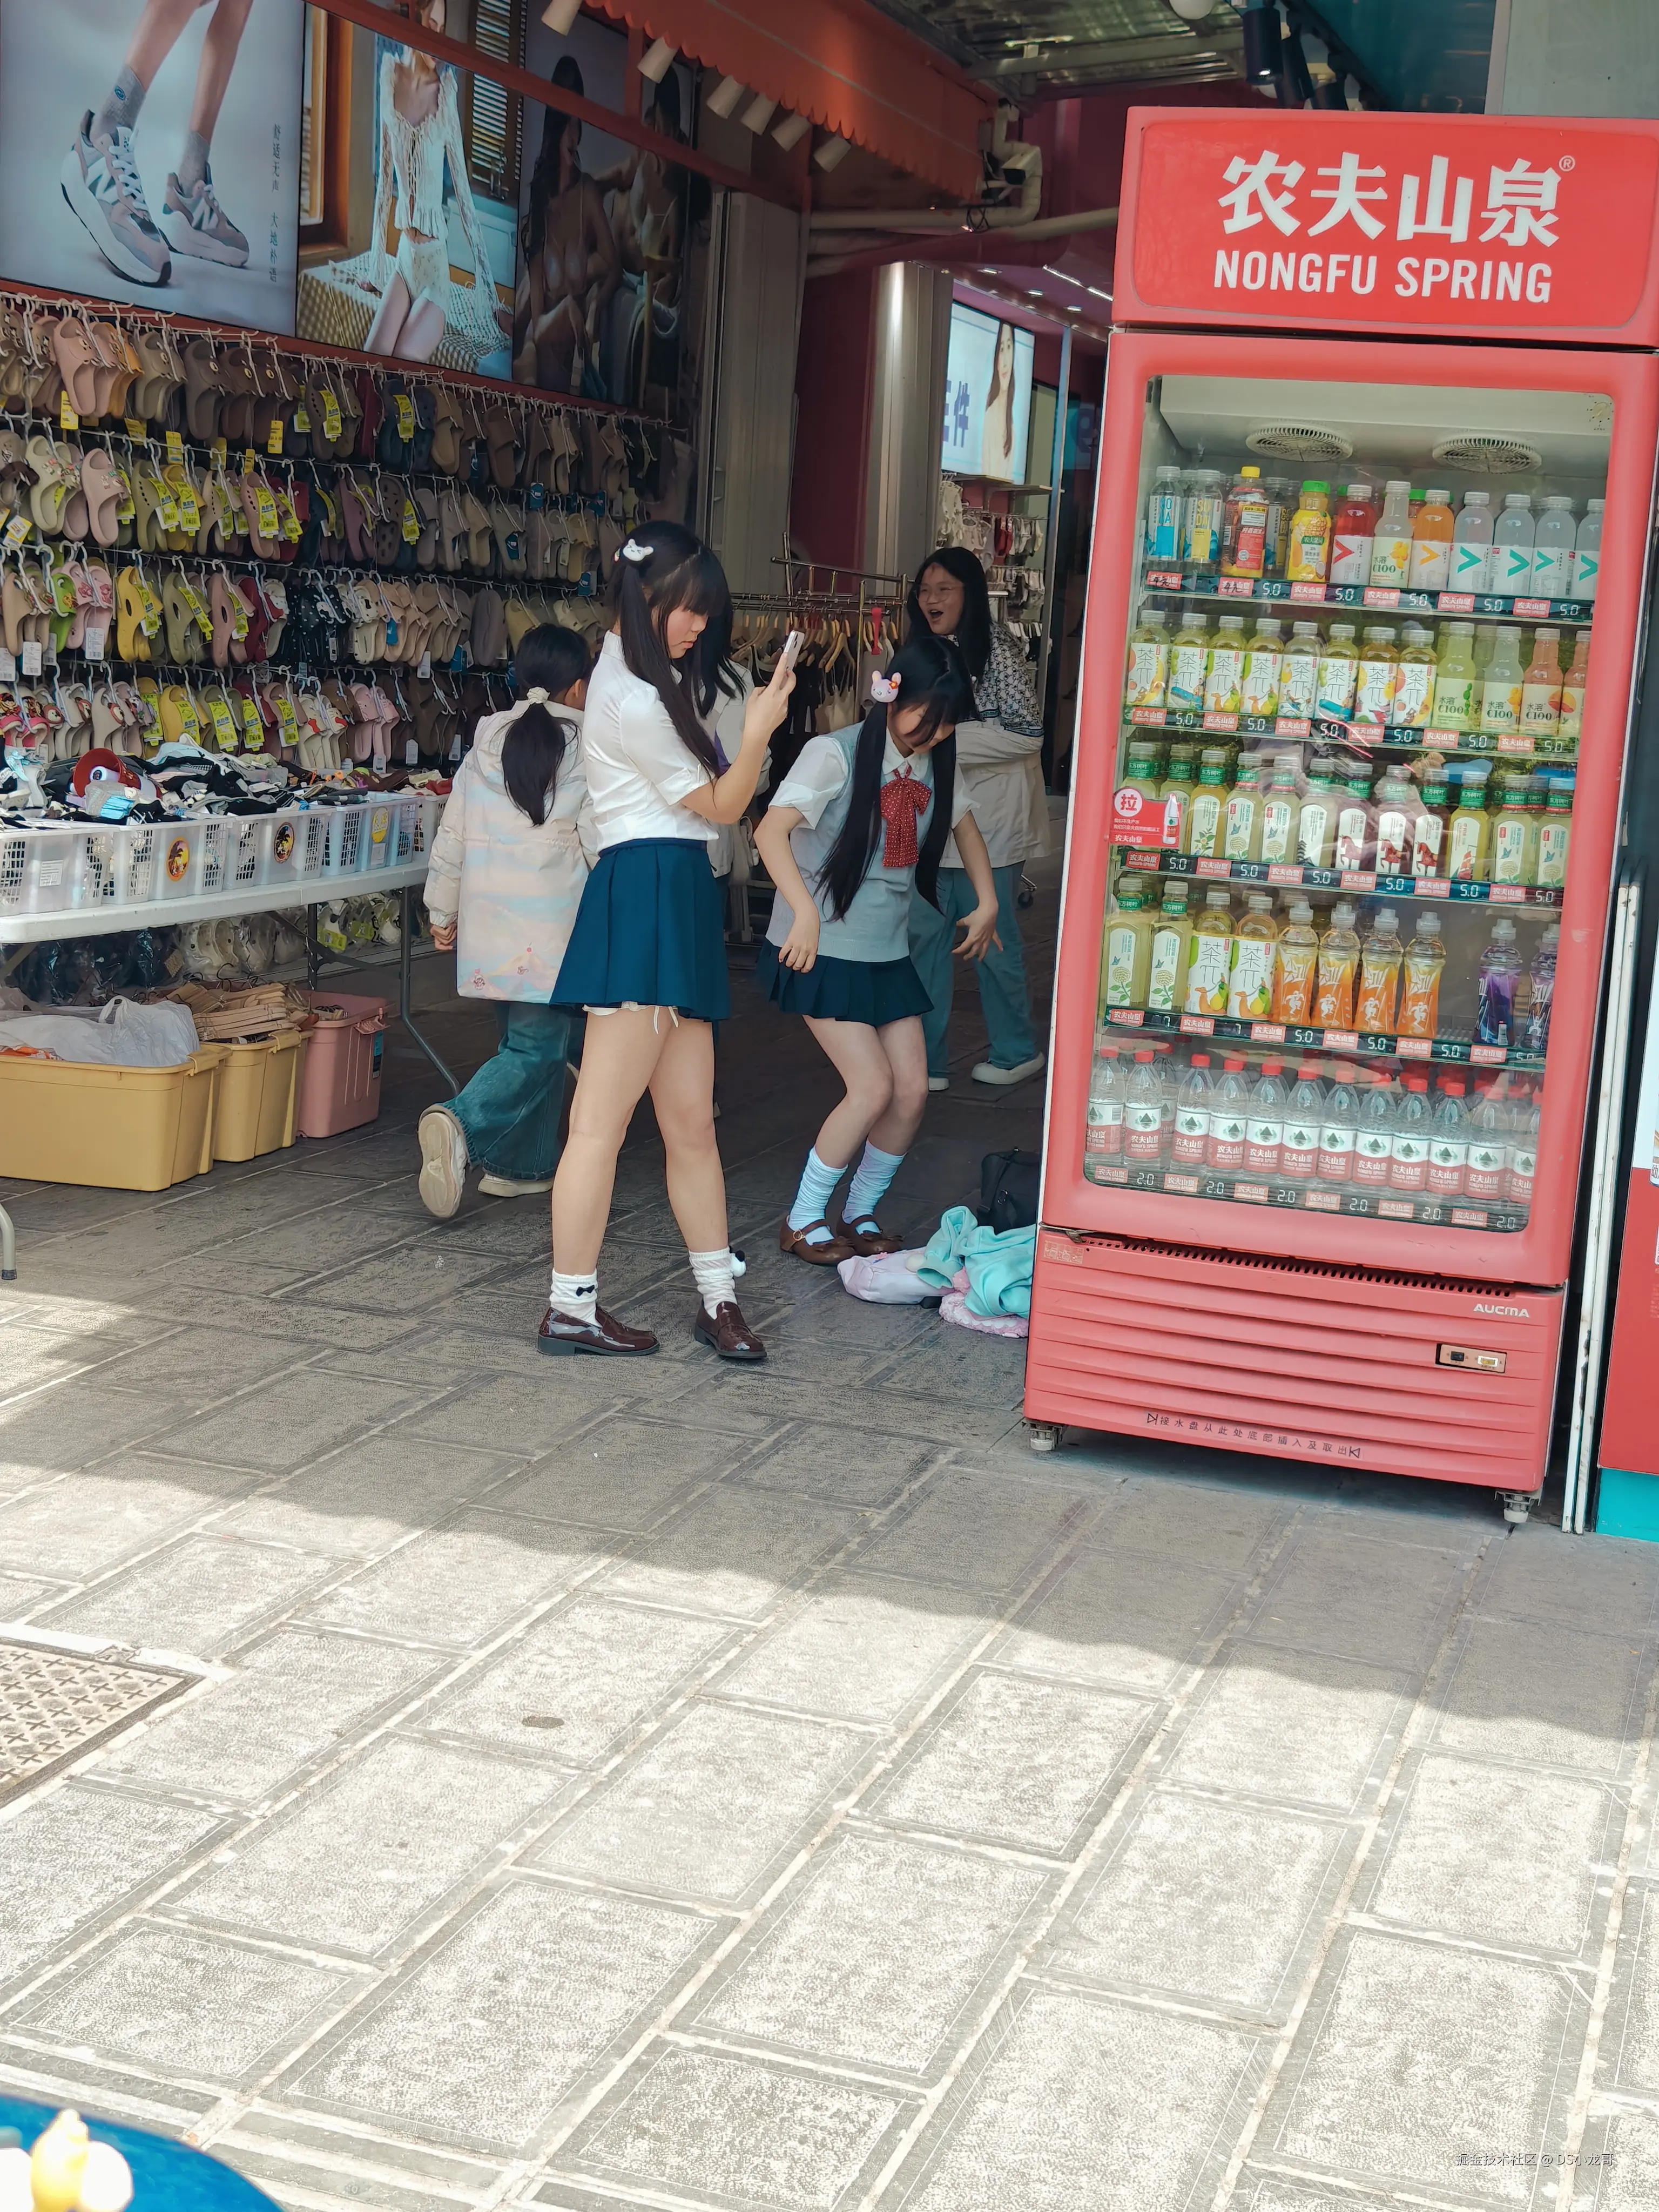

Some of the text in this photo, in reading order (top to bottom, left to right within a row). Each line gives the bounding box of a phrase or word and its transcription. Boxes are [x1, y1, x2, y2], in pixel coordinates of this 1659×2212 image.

[1218, 150, 1562, 248] 农夫山泉
[1213, 250, 1553, 303] NONGFU SPRING
[1263, 583, 1280, 596] 5.0
[1335, 588, 1354, 602] 5.0
[1410, 593, 1427, 606] 5.0
[1484, 598, 1502, 612] 5.0
[1560, 604, 1579, 617] 5.0
[1438, 705, 1463, 714] C100
[1487, 710, 1512, 719] C100
[1526, 711, 1552, 721] C100
[1175, 712, 1193, 725] 5.0
[1247, 718, 1265, 732] 5.0
[1320, 723, 1338, 737] 5.0
[1393, 729, 1412, 743] 5.0
[1468, 734, 1487, 748] 5.0
[1544, 741, 1562, 753] 5.0
[1121, 794, 1137, 811] 拉
[1169, 857, 1187, 871] 5.0
[1240, 864, 1258, 878] 5.0
[1312, 870, 1330, 884] 5.0
[1386, 877, 1404, 891] 5.0
[1460, 884, 1478, 898] 5.0
[1535, 890, 1553, 903] 5.0
[1295, 1029, 1313, 1043] 5.0
[1367, 1036, 1385, 1050] 5.0
[1441, 1044, 1459, 1057] 5.0
[1137, 1172, 1154, 1186] 2.0
[1206, 1181, 1224, 1194] 2.0
[1277, 1189, 1295, 1203] 2.0
[1350, 1197, 1367, 1211] 2.0
[1422, 1206, 1441, 1220] 2.0
[1496, 1215, 1515, 1229] 2.0
[1473, 1304, 1529, 1318] AUCMA
[1159, 1415, 1347, 1455] 接水盘从此处底部插入及取出
